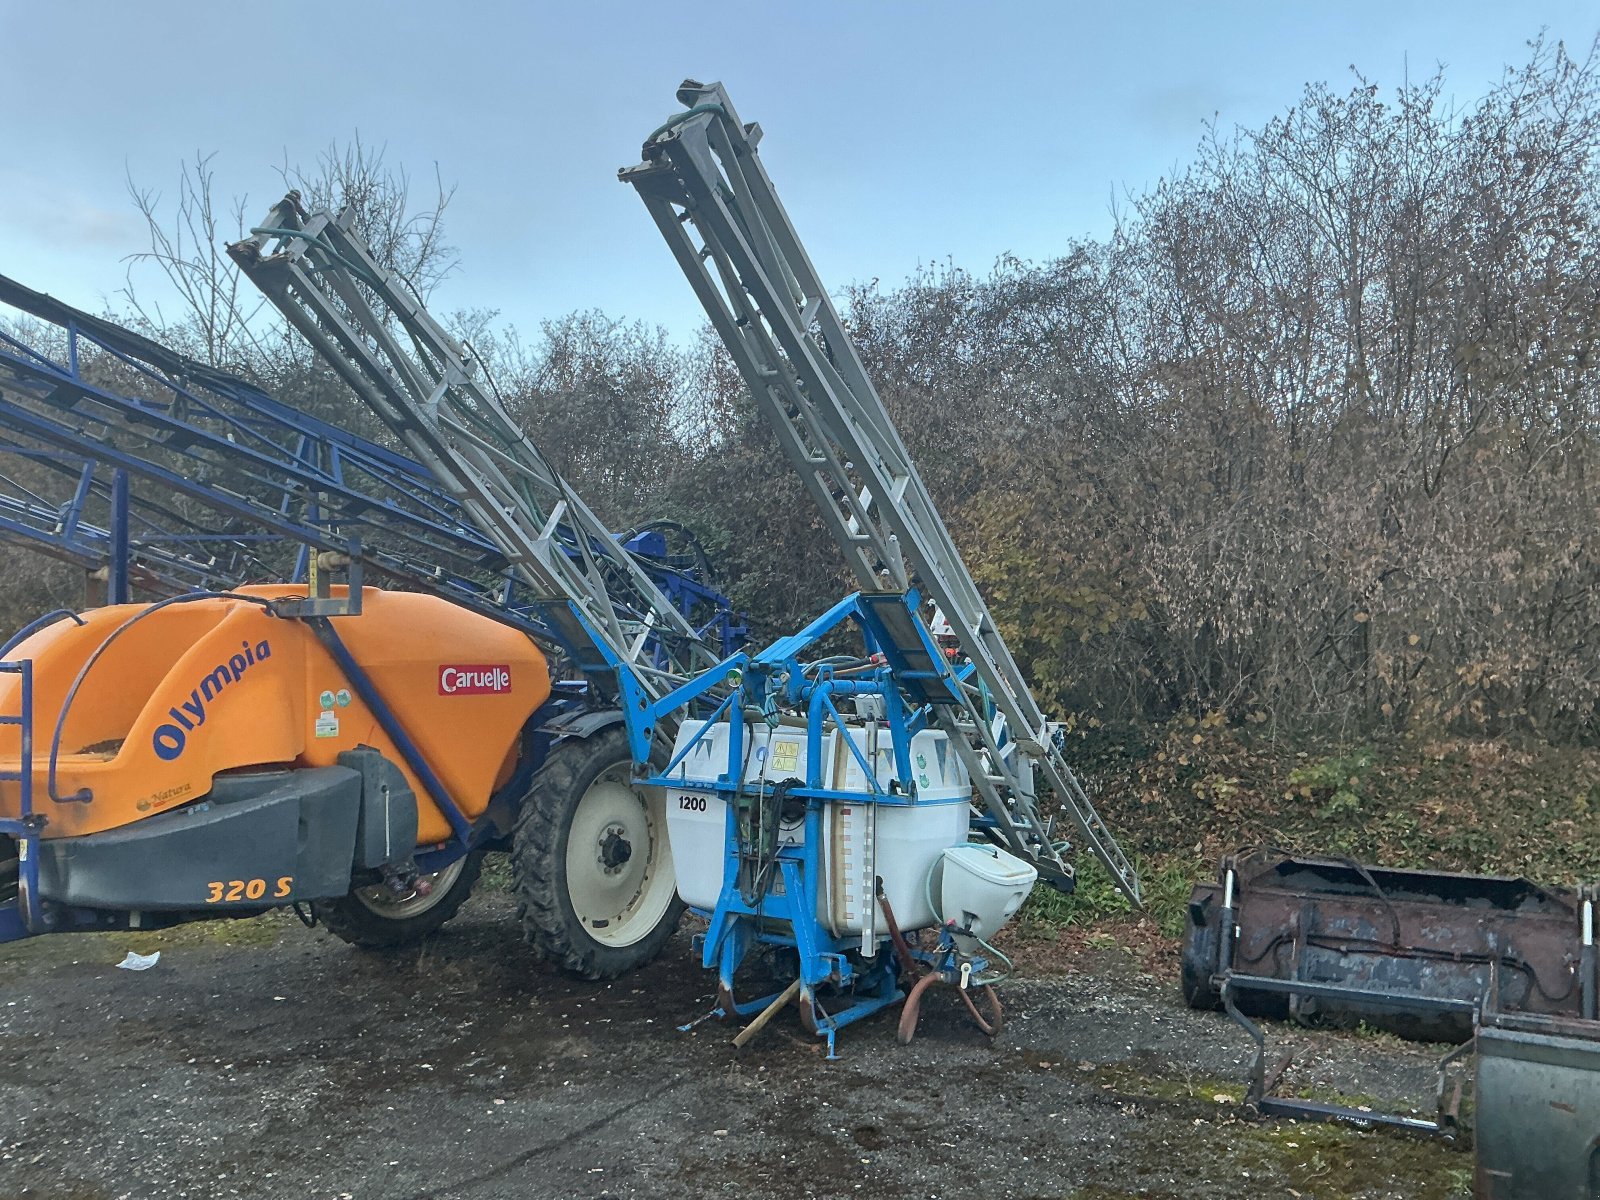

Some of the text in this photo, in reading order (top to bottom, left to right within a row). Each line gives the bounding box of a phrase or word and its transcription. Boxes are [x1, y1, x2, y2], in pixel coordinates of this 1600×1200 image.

[441, 667, 509, 692] Caruelle
[152, 639, 271, 761] Olympia
[151, 783, 191, 801] Natura
[679, 795, 707, 812] 1200
[205, 876, 294, 903] 320 S
